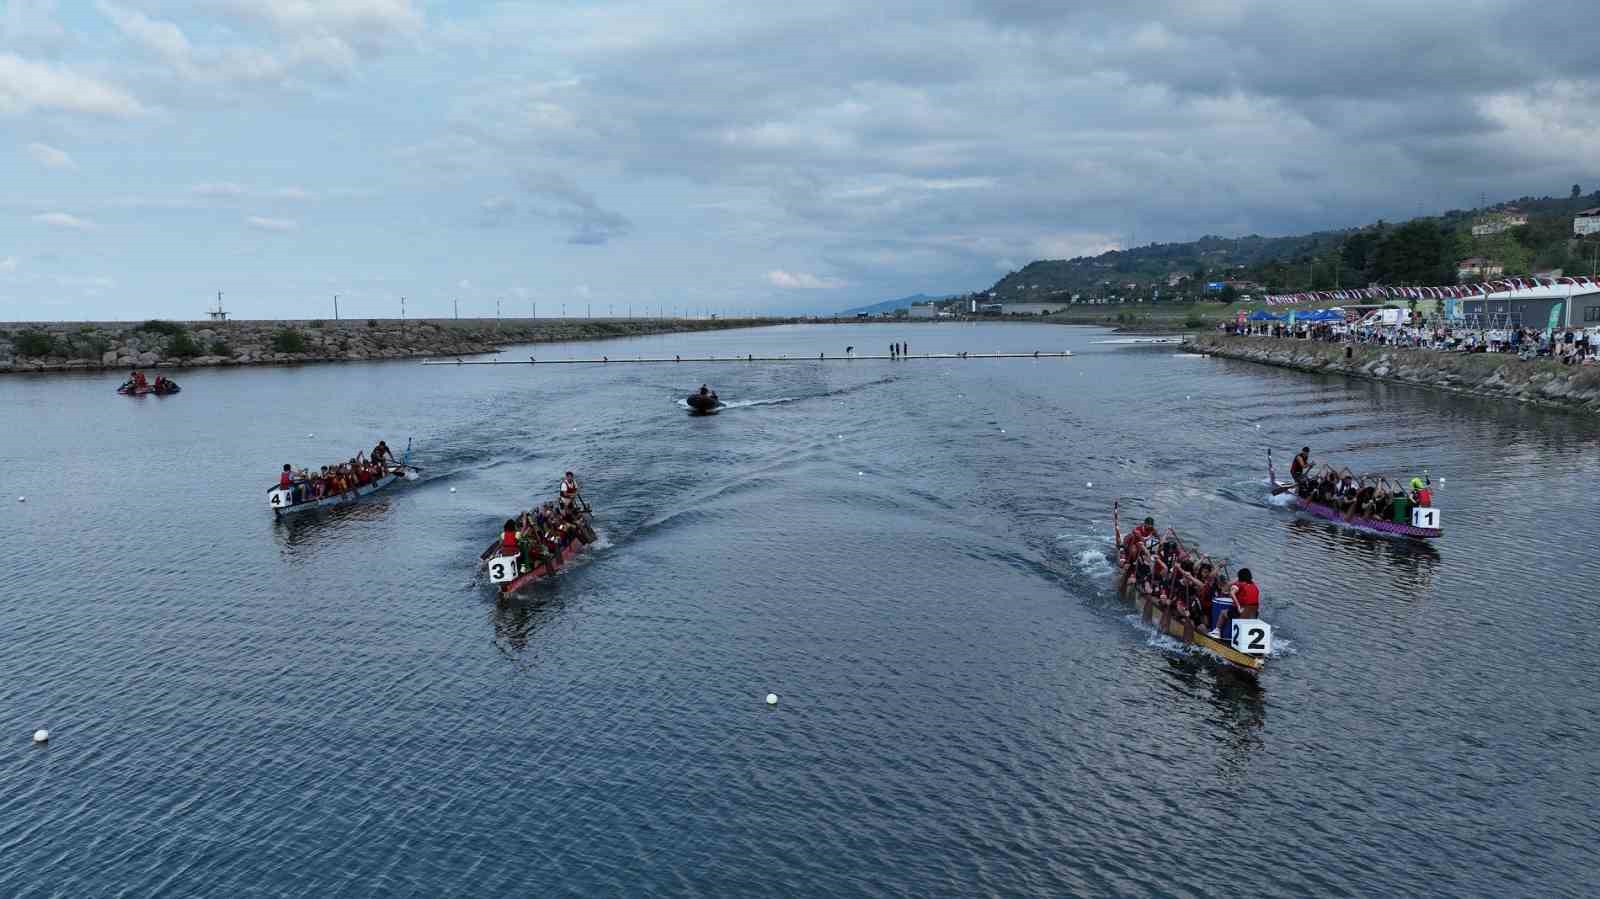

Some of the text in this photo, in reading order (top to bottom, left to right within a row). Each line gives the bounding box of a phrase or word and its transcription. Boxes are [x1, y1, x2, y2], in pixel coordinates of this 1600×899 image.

[272, 494, 280, 505] 4
[1414, 511, 1419, 525] 1
[1424, 512, 1433, 525] 1
[492, 564, 505, 579] 3
[1233, 624, 1240, 646] 2
[1248, 628, 1265, 649] 2
